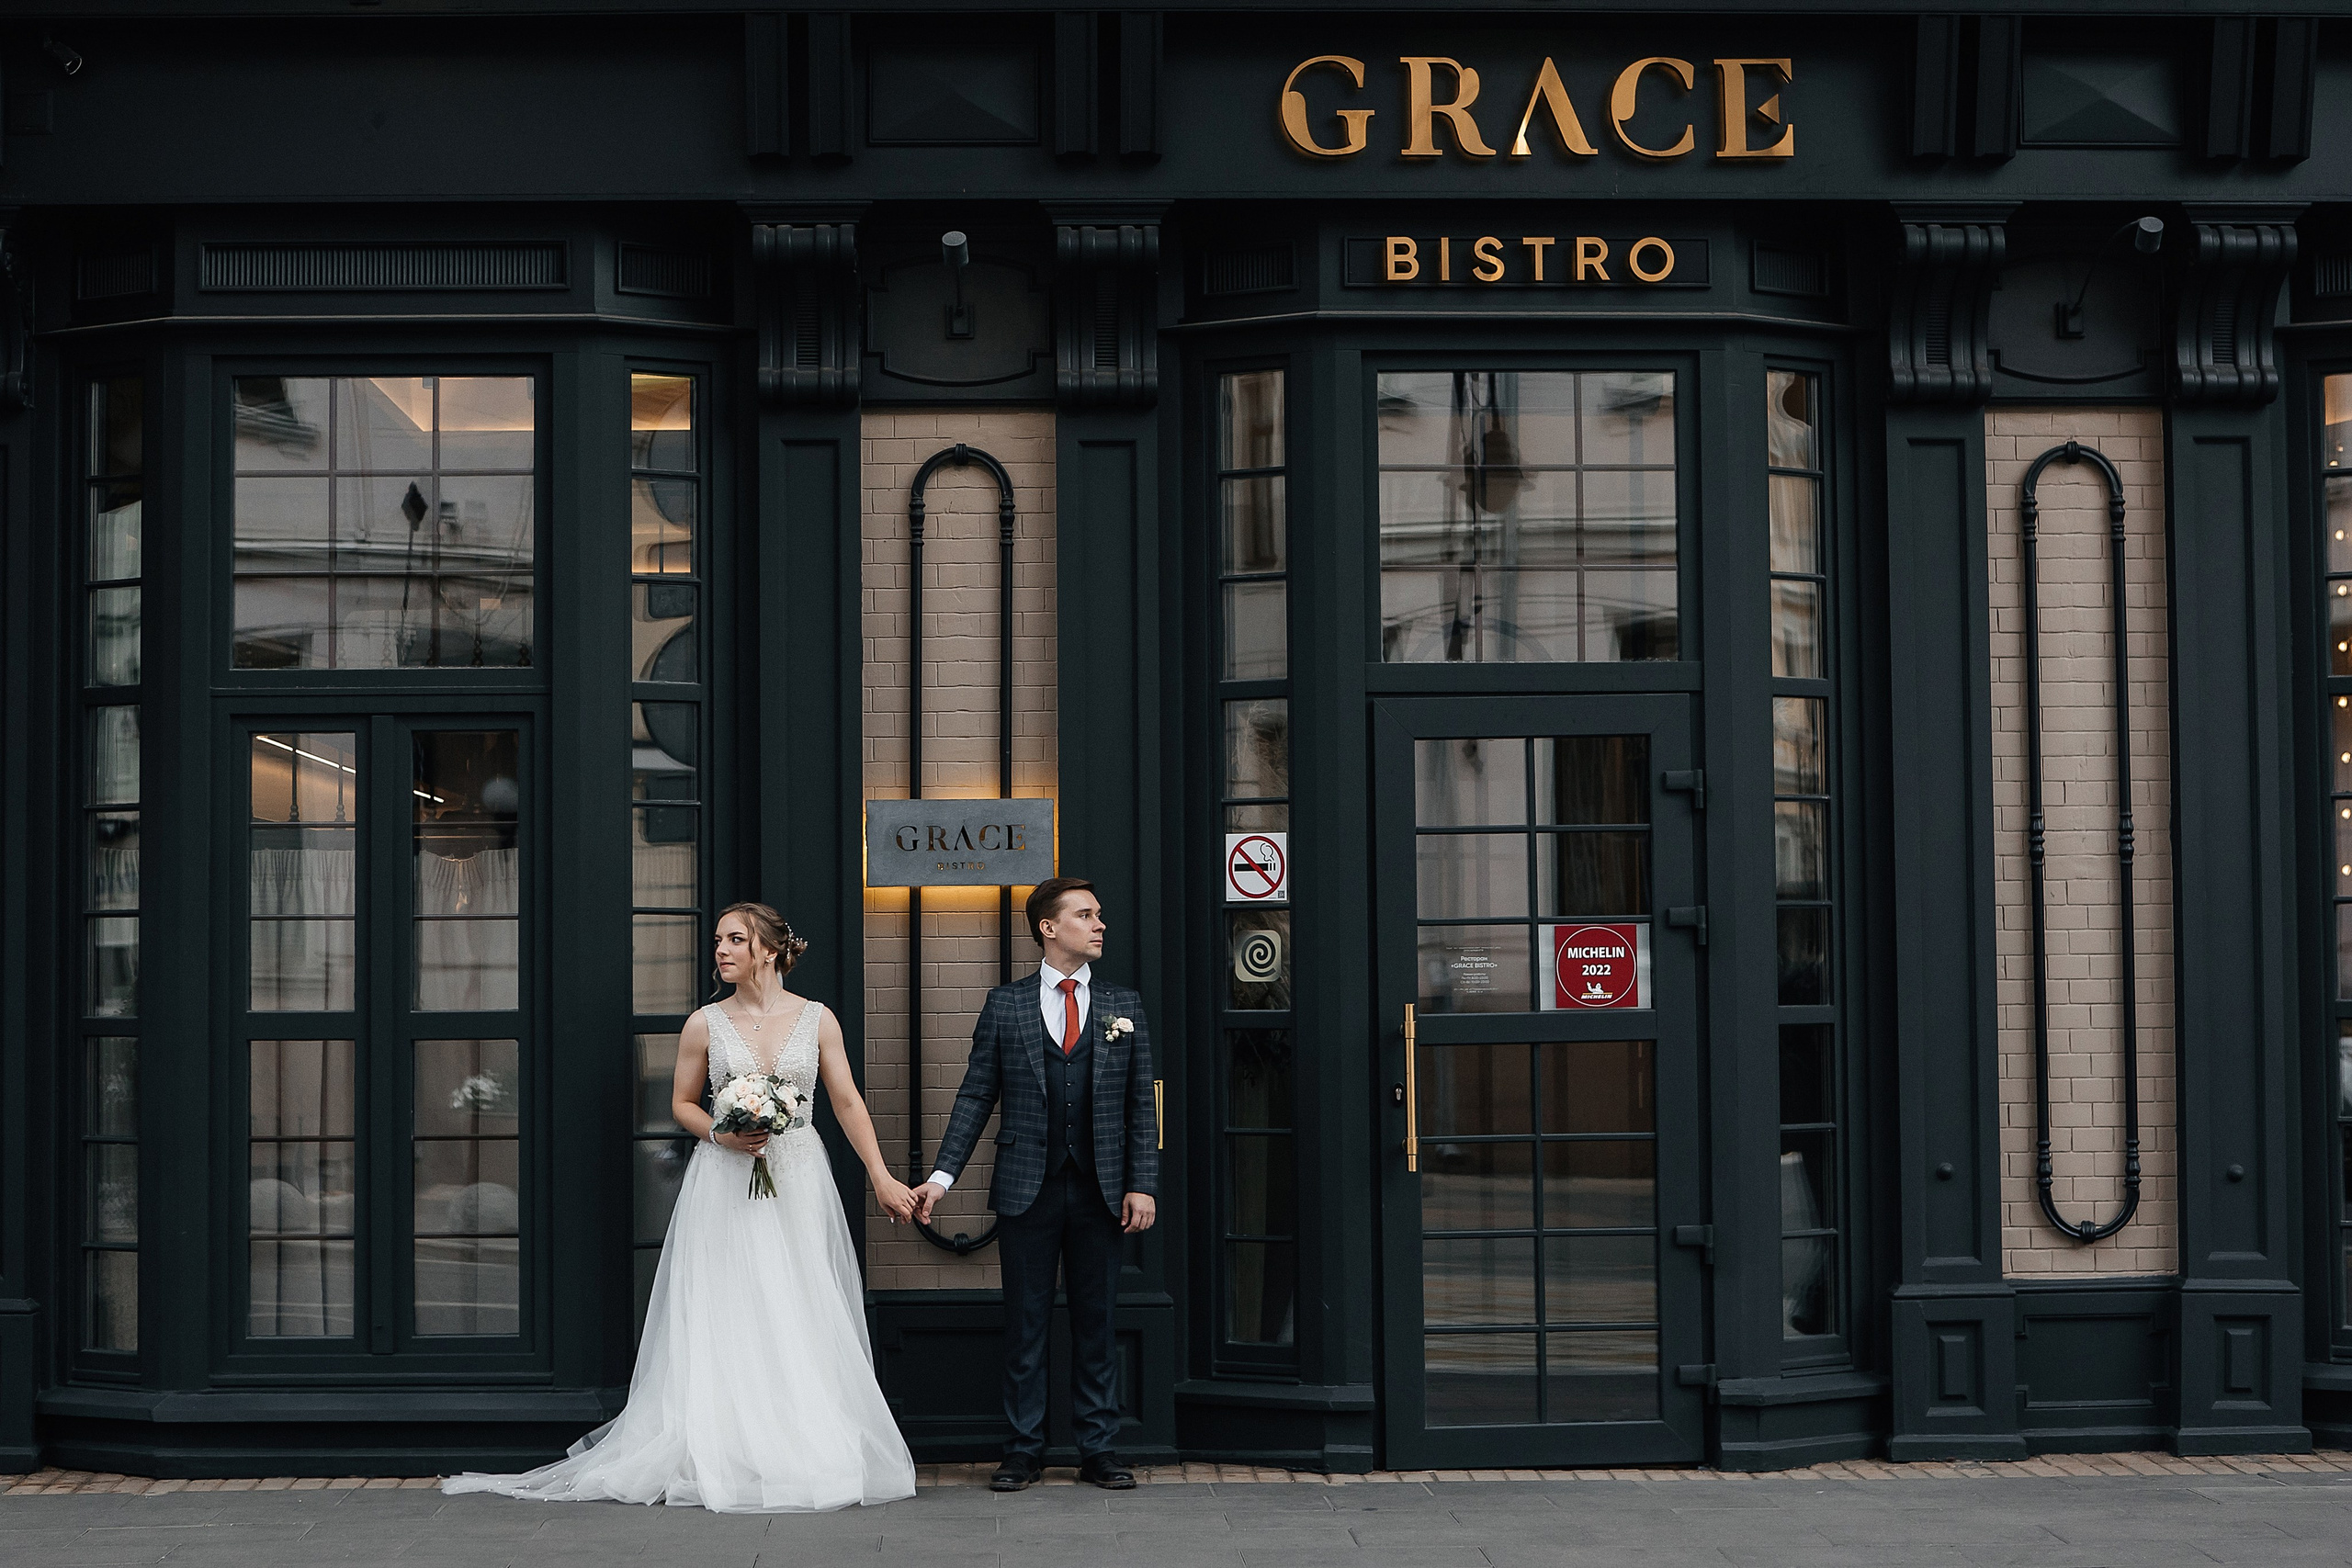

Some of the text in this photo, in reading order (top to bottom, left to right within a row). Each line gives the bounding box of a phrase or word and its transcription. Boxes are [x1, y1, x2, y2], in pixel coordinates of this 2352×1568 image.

[1281, 55, 1794, 158] GRACE
[1386, 236, 1675, 282] BISTRO
[896, 824, 1026, 852] GRACE
[936, 862, 986, 871] BISTRO
[1567, 946, 1625, 959] MICHELIN
[1582, 964, 1611, 976] 2022
